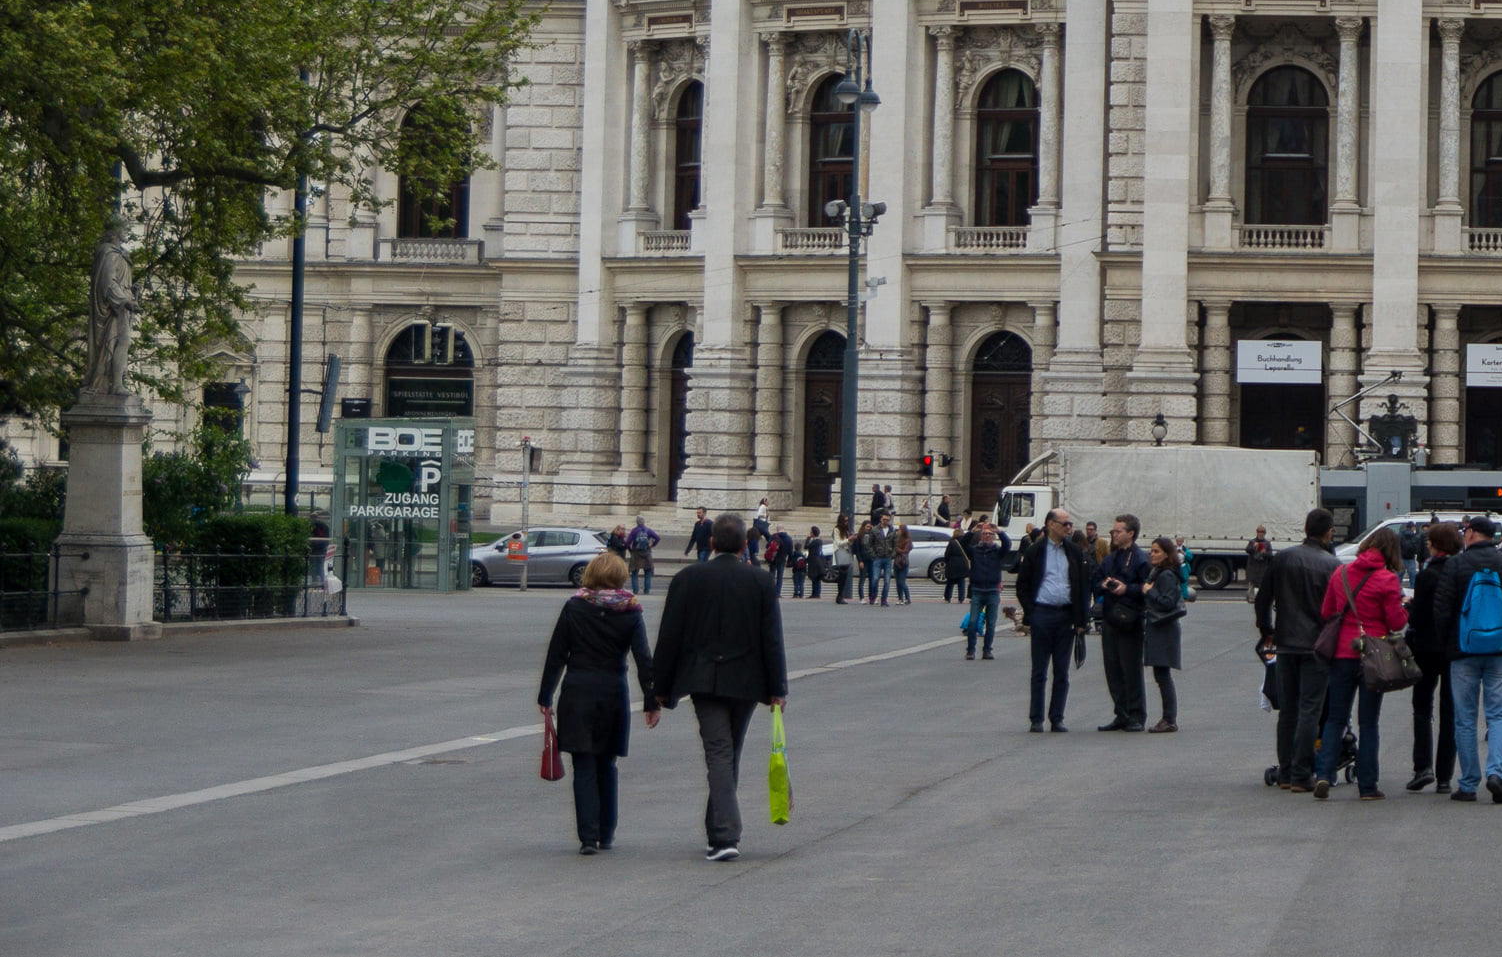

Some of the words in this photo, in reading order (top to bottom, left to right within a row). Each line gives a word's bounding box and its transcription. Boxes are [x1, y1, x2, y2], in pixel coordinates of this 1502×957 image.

[368, 427, 442, 451] BOE
[384, 492, 439, 504] ZUGANG
[350, 505, 439, 518] PARKGARAGE
